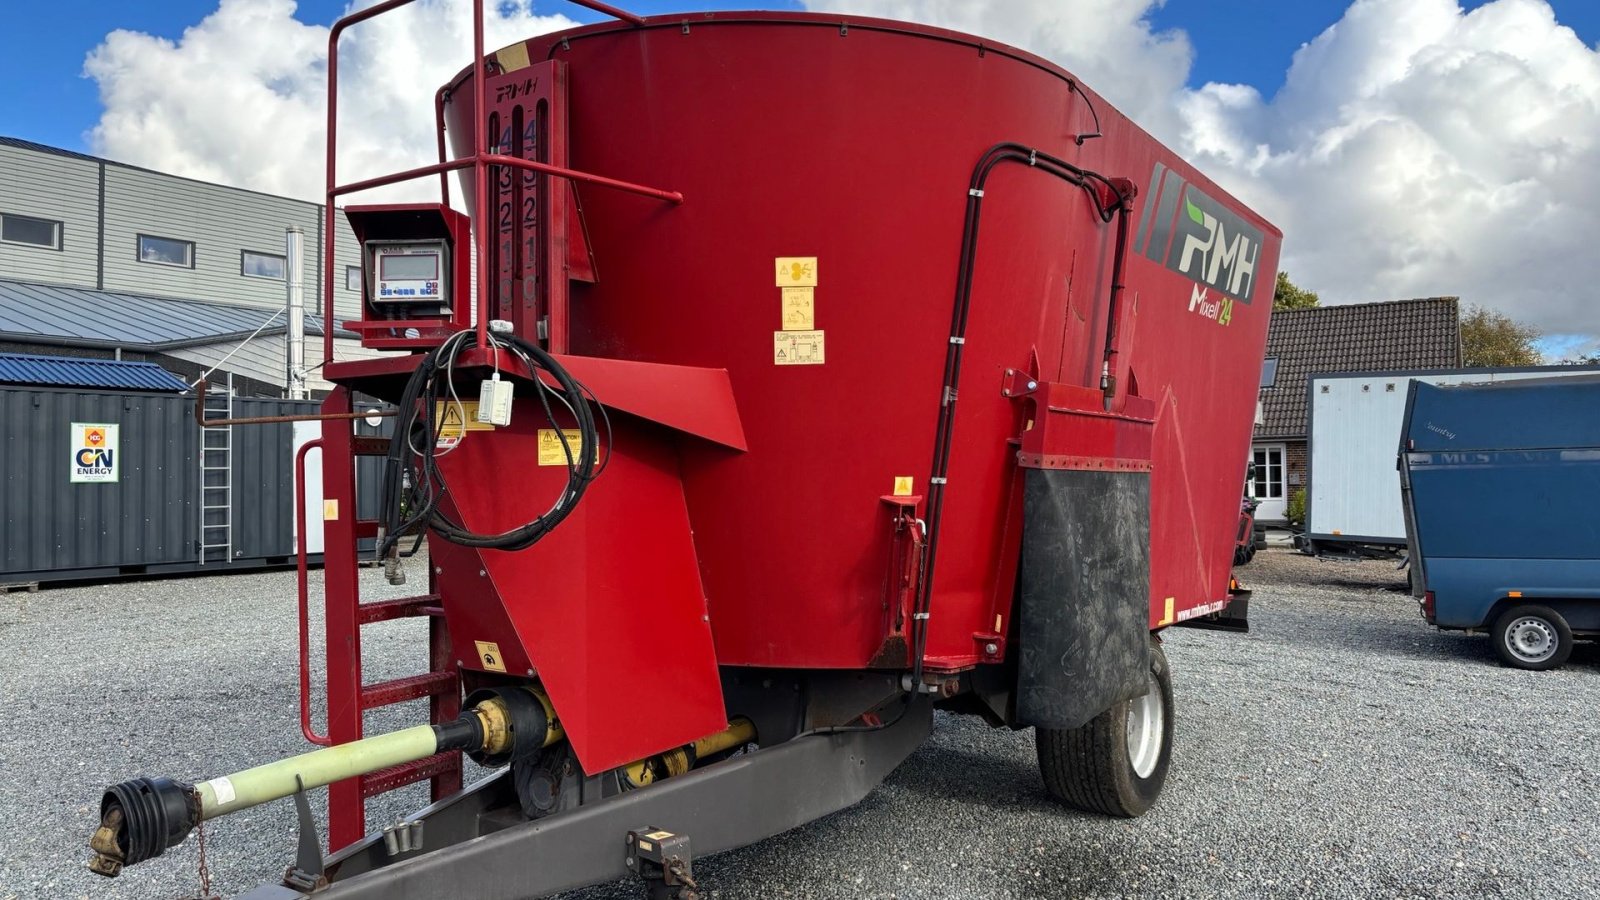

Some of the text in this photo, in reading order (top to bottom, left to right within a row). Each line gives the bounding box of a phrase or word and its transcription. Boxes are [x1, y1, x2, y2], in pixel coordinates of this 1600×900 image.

[499, 126, 511, 150] 4
[524, 119, 536, 144] 4
[500, 165, 511, 189] 3
[500, 202, 511, 227] 2
[524, 197, 536, 223] 2
[501, 240, 511, 266] 1
[525, 236, 535, 262] 1
[1179, 196, 1258, 299] RMH
[500, 279, 512, 304] 0
[523, 275, 536, 301] 0
[1188, 283, 1233, 326] Mixell 24
[76, 448, 113, 467] CN
